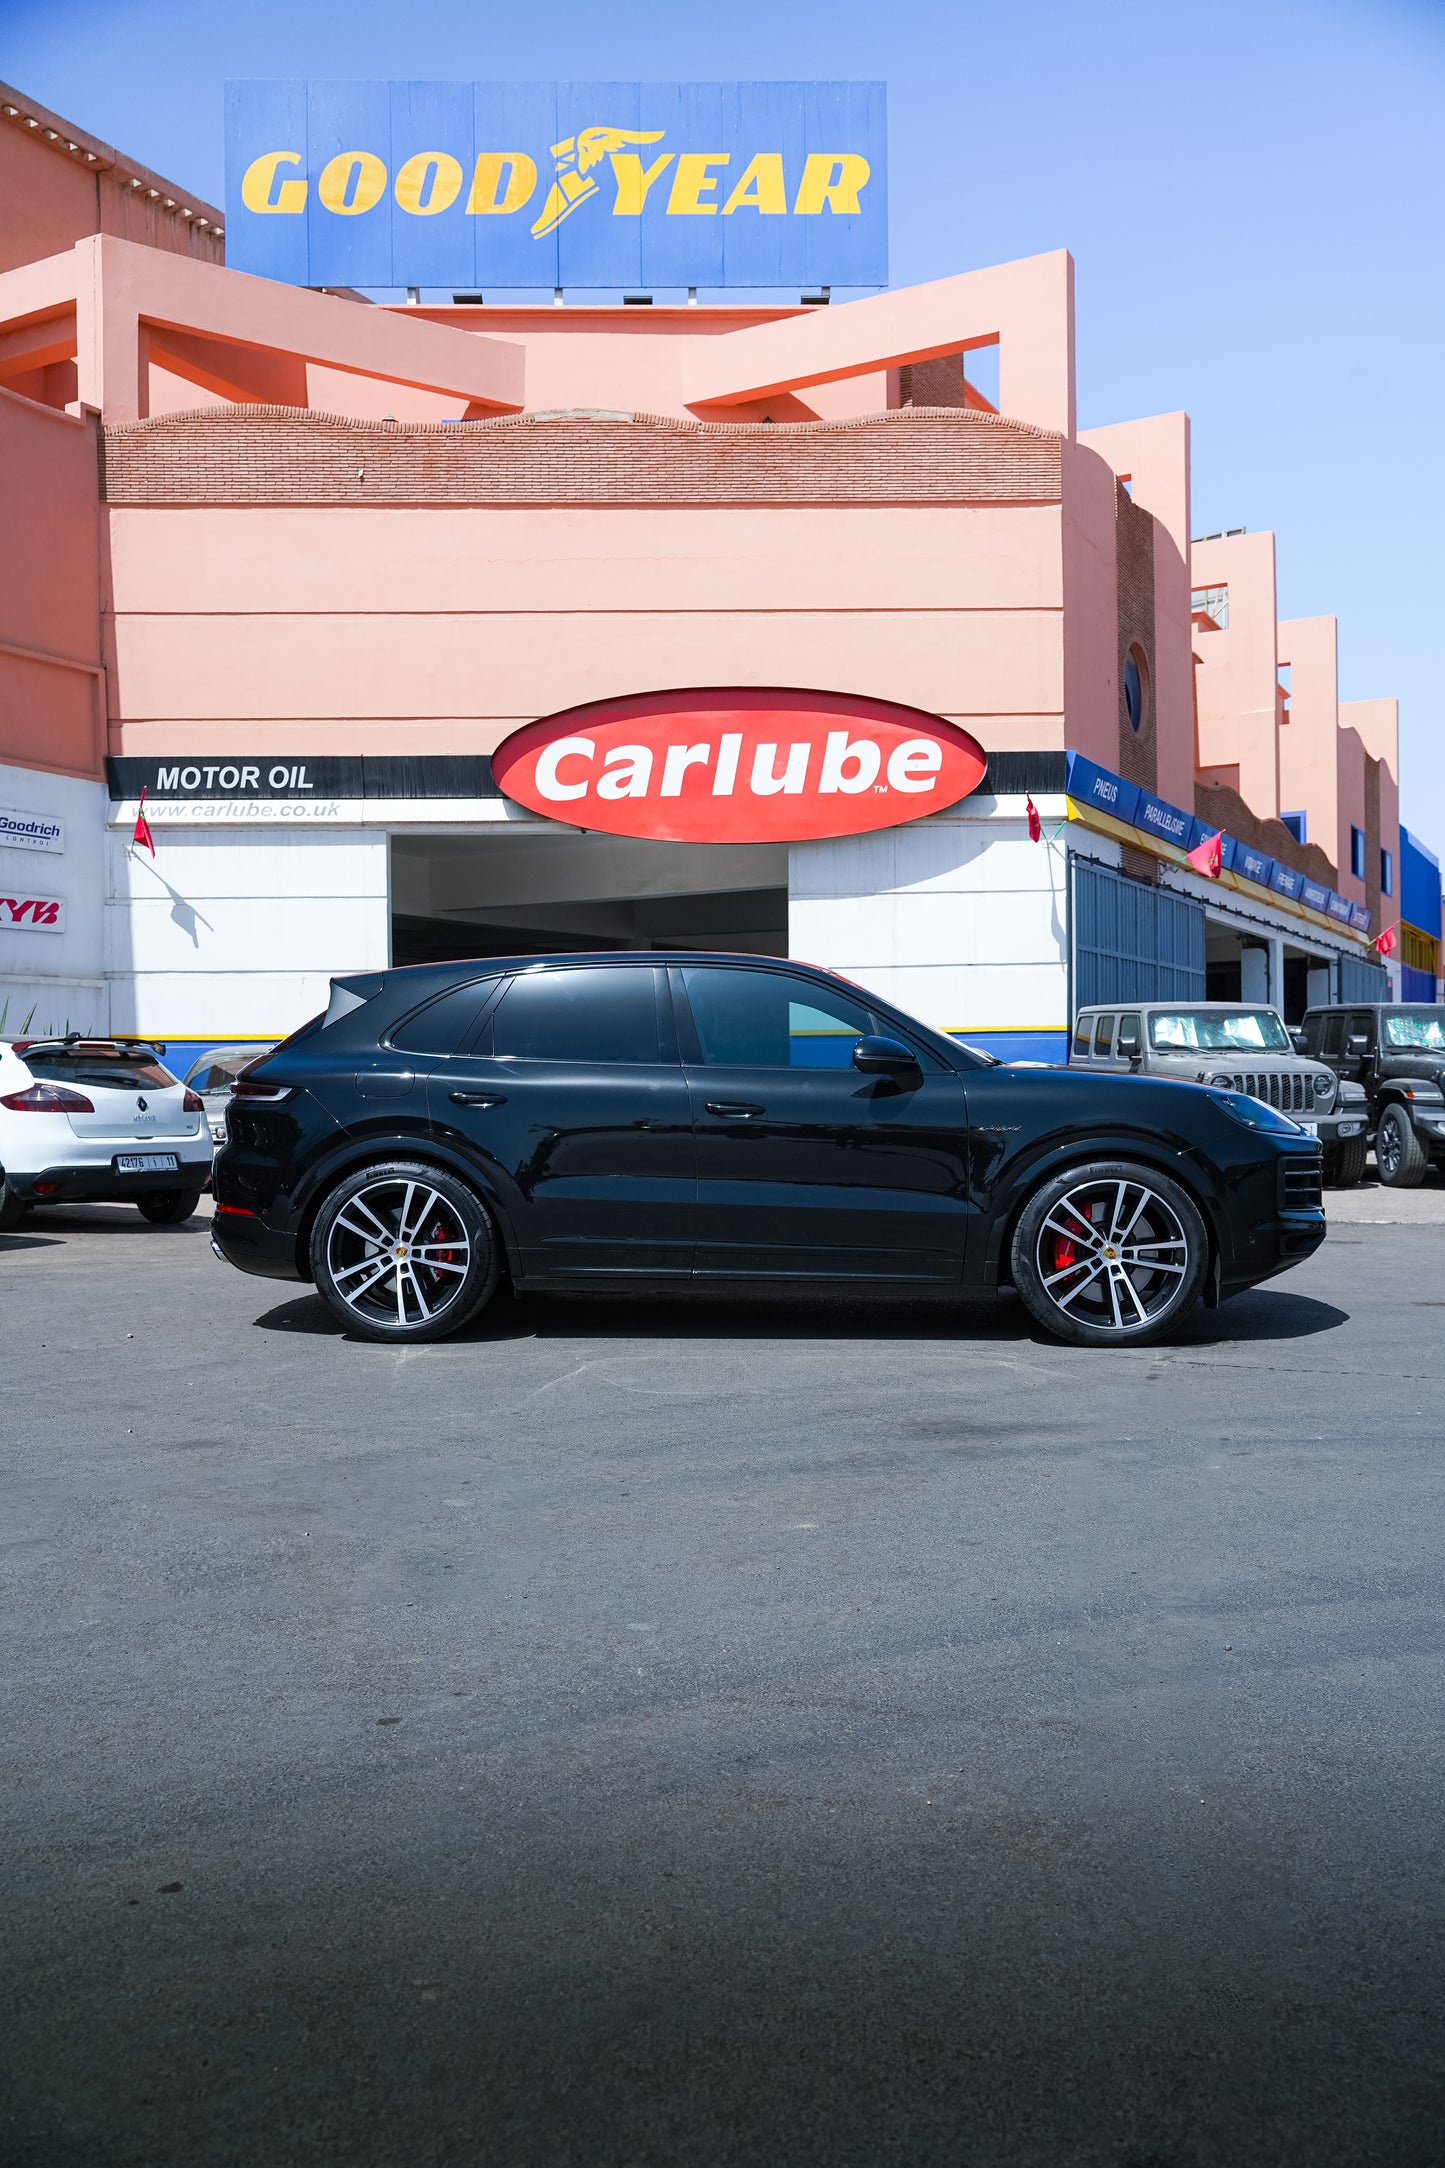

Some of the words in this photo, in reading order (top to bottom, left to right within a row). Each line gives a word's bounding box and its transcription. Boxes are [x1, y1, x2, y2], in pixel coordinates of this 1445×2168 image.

[156, 766, 260, 790] MOTOR
[268, 766, 314, 789] OIL
[534, 731, 943, 801] Carlube
[1093, 777, 1118, 803] PNEUS
